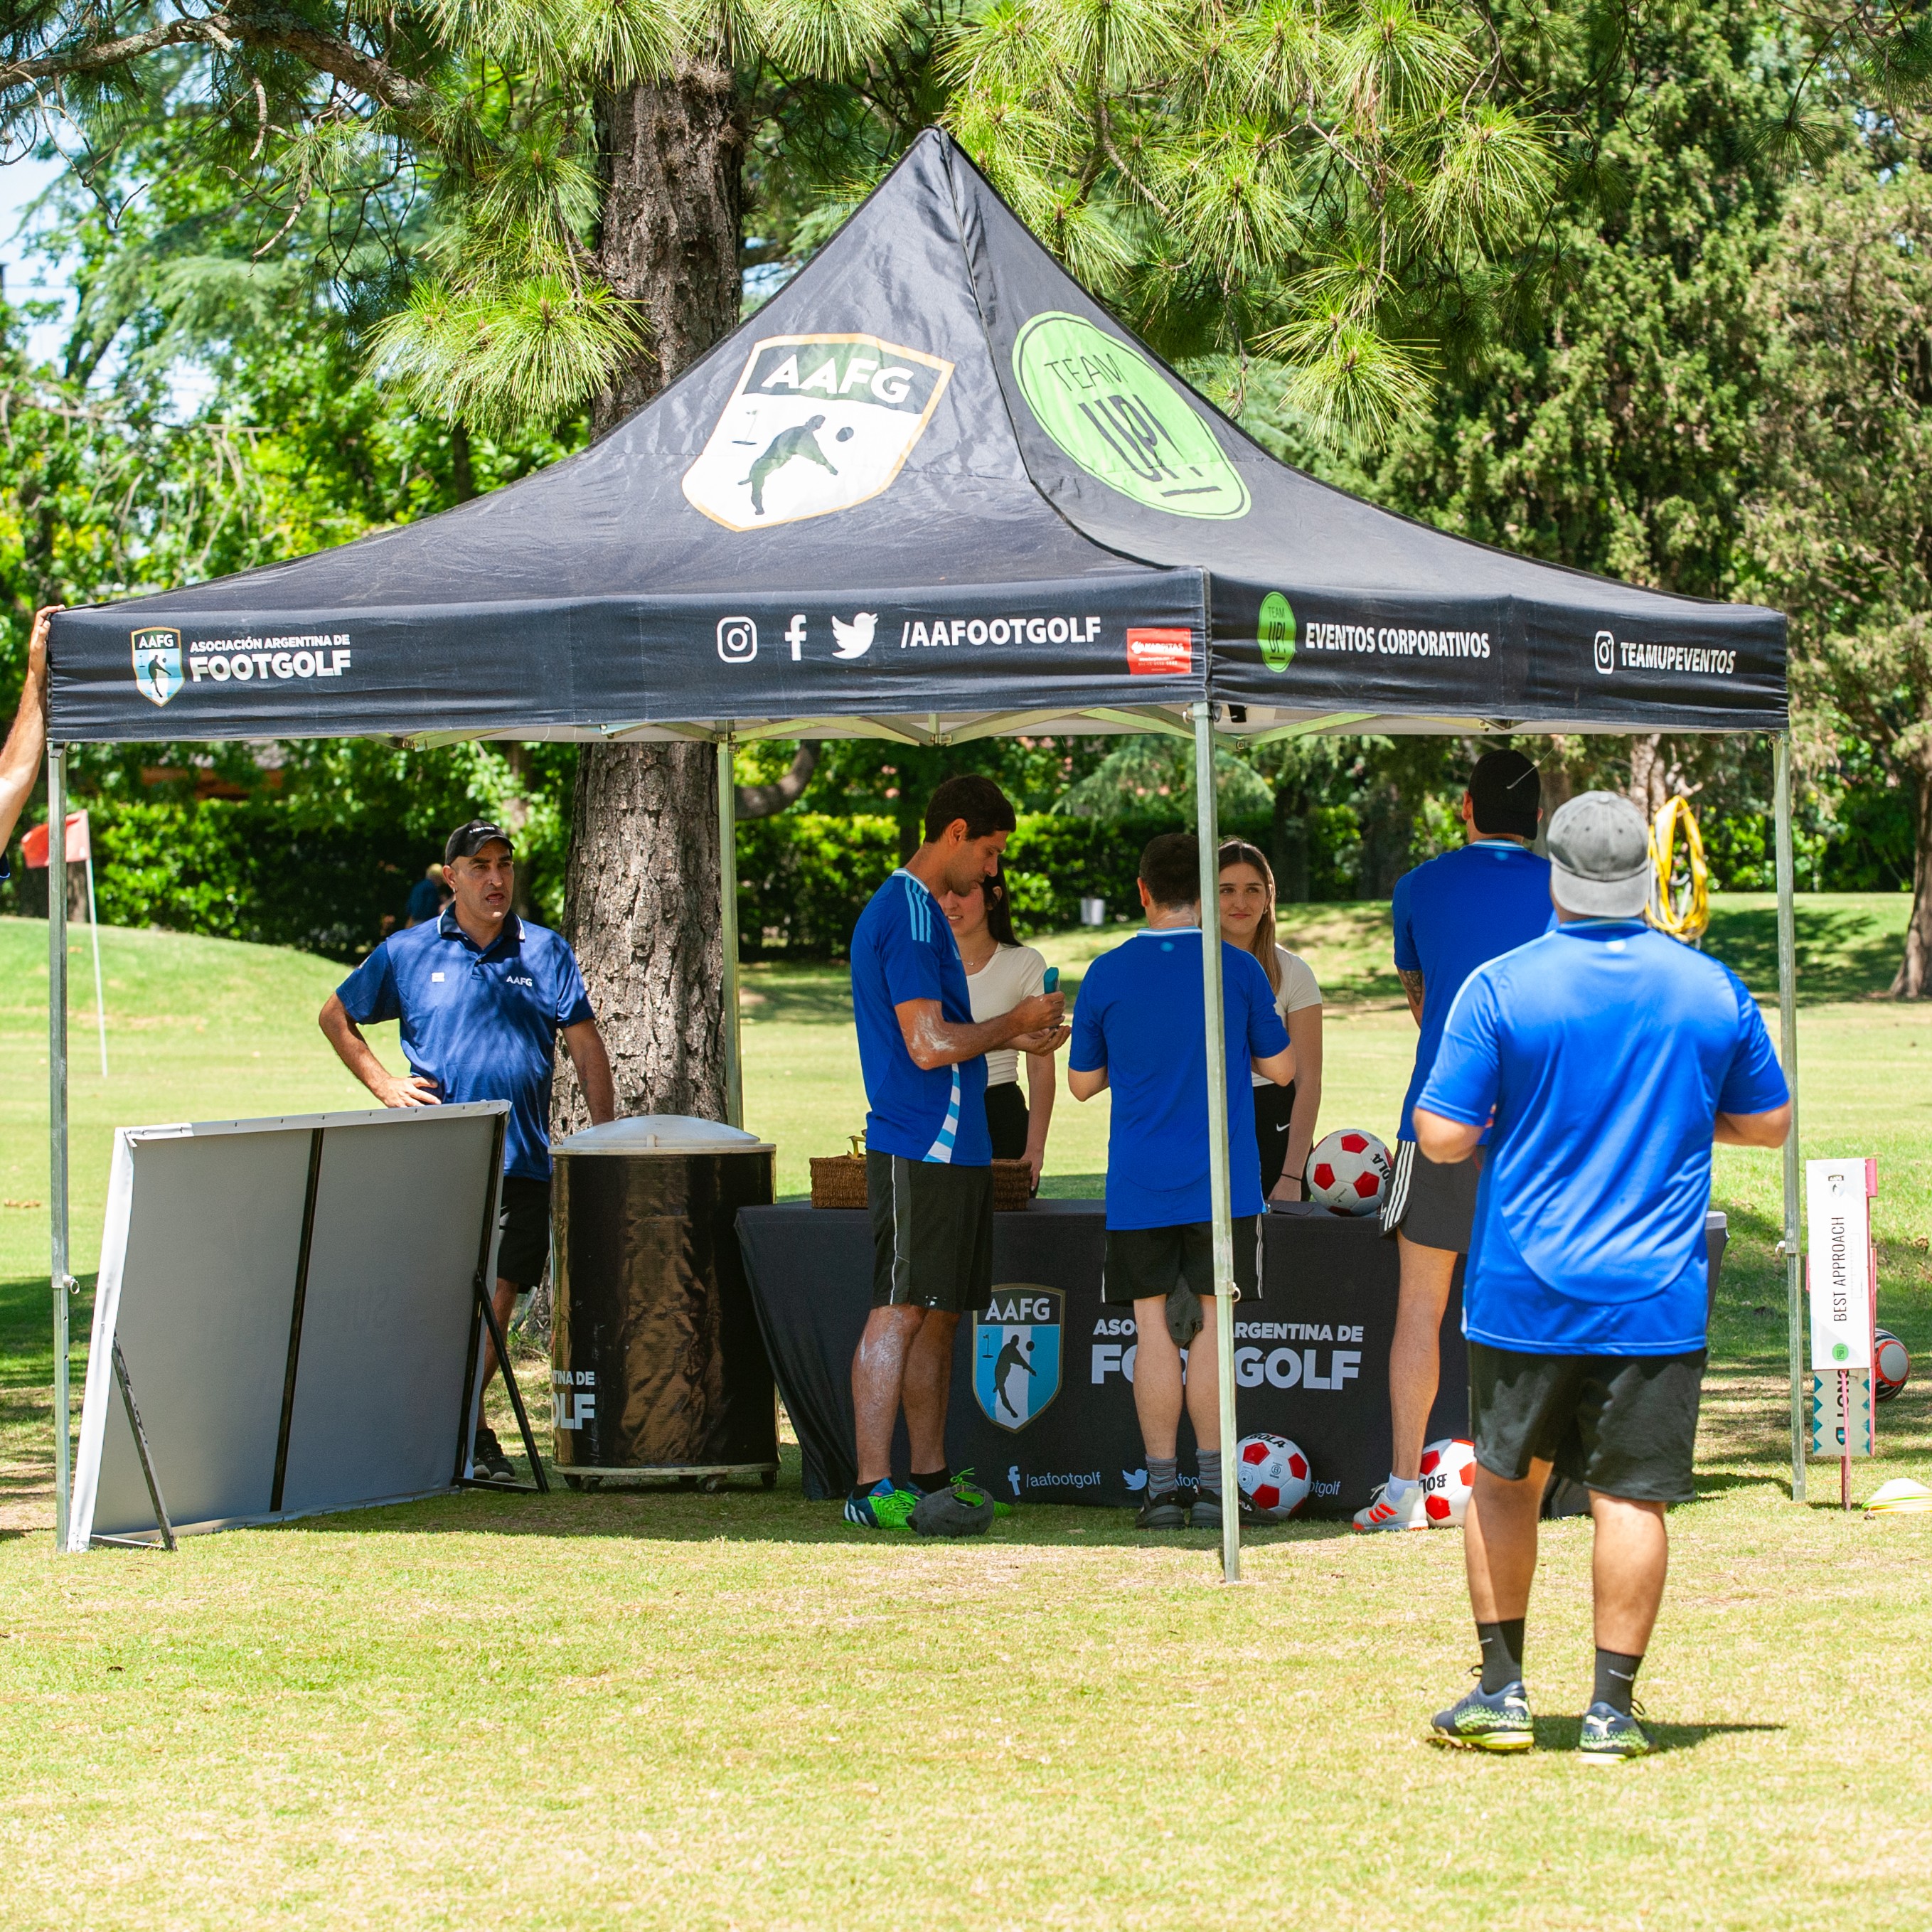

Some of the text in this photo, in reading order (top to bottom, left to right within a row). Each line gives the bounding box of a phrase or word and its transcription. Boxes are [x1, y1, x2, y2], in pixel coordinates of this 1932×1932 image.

[761, 353, 914, 404] AAFG
[1044, 353, 1128, 391] TEAM
[1077, 394, 1204, 482] UP!
[1267, 606, 1285, 619] TEAM
[138, 634, 174, 649] AAFG
[189, 634, 351, 653] ASOCIACIÓN ARGENTINA DE
[900, 617, 1101, 649] /AAFOOTGOLF
[1268, 621, 1286, 653] UP!
[1306, 622, 1490, 658] EVENTOS CORPORATIVOS
[189, 649, 351, 683] FOOTGOLF
[1620, 642, 1736, 673] TEAMUPEVENTOS
[506, 976, 533, 987] AAFG
[1831, 1217, 1847, 1321] BEST APPROACH
[985, 1298, 1050, 1320] AAFG
[1337, 1325, 1364, 1343] DE
[576, 1371, 595, 1386] DE
[1026, 1471, 1101, 1488] /aafootgolf
